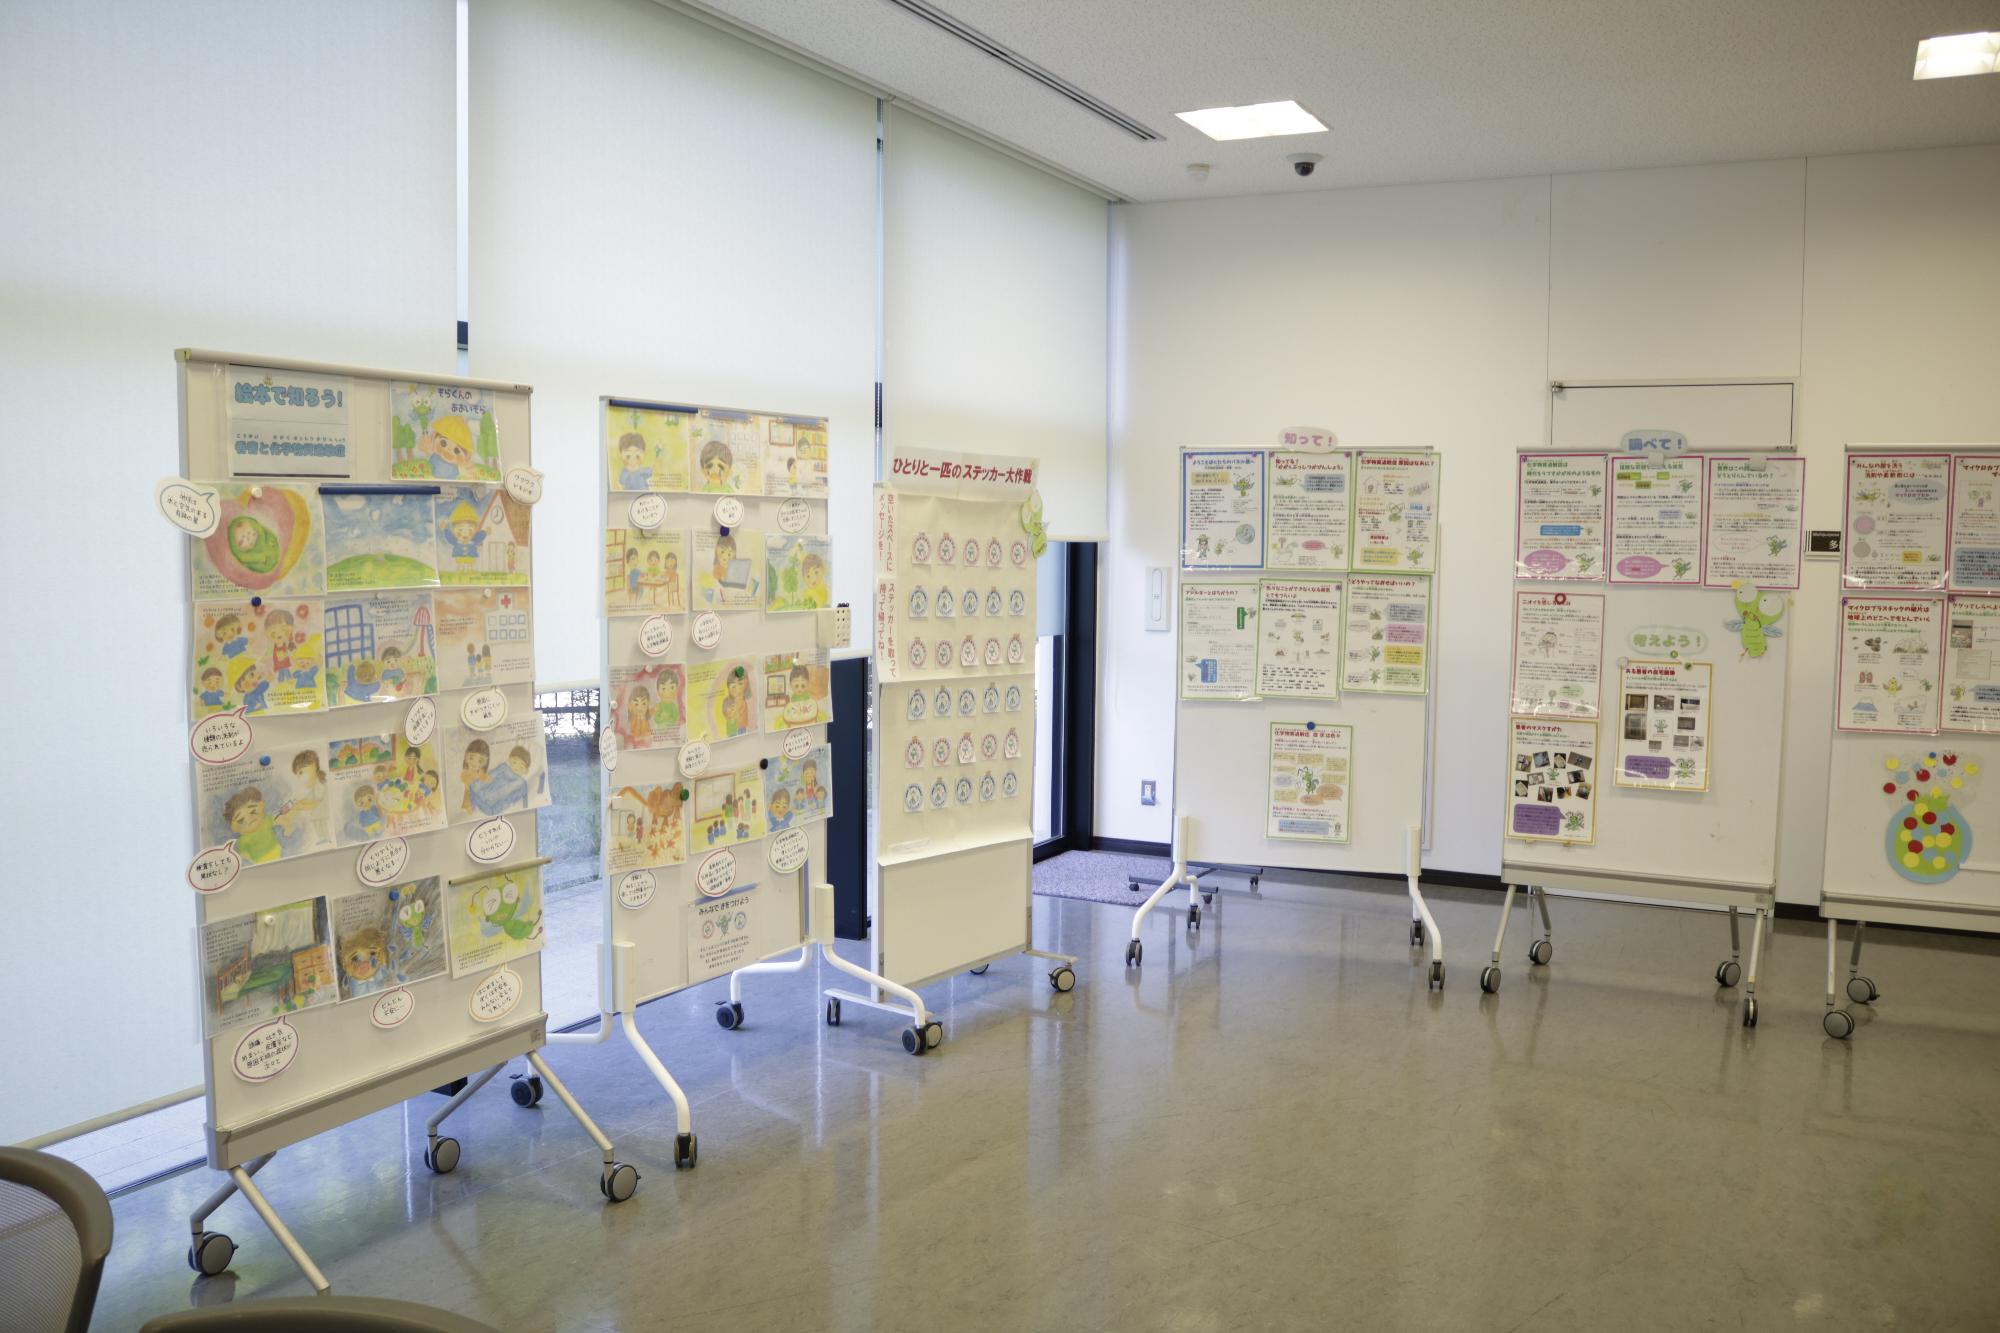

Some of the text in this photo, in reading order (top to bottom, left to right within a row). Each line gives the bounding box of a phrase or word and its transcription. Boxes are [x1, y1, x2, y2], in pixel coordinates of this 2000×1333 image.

[893, 457, 1033, 485] ひとりと一匹のステッカー大作戦
